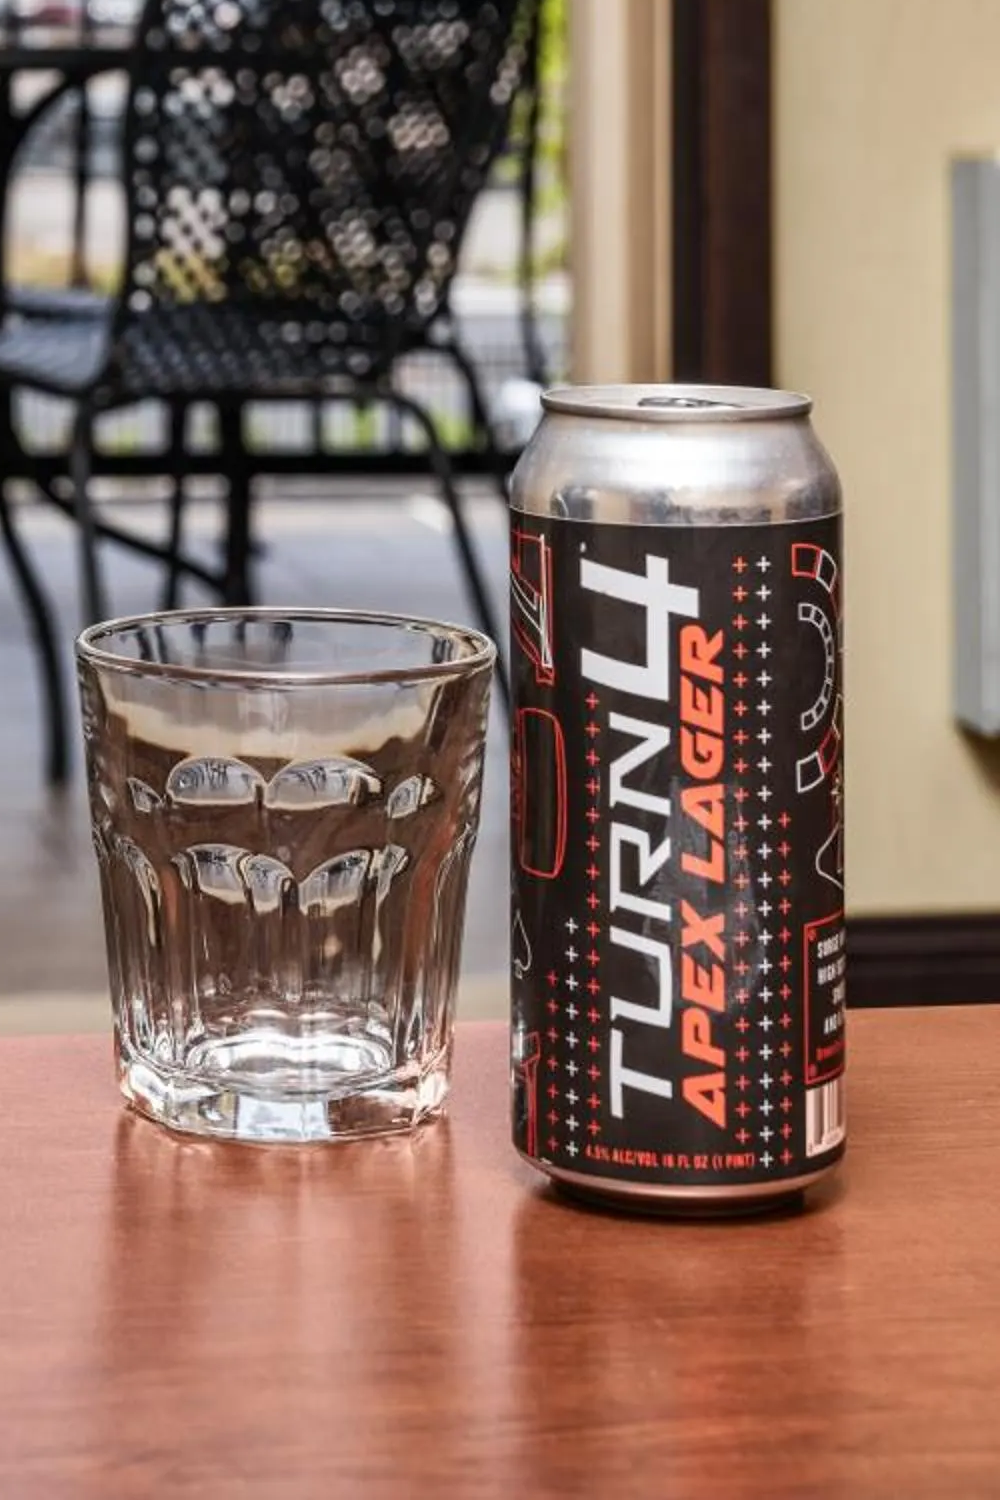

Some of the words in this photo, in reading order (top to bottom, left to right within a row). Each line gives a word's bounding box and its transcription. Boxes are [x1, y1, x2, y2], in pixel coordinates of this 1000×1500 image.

[679, 623, 726, 884] LAGER
[680, 899, 727, 1130] APEX
[612, 1147, 659, 1168] ALC/VOL
[693, 1153, 709, 1170] OZ
